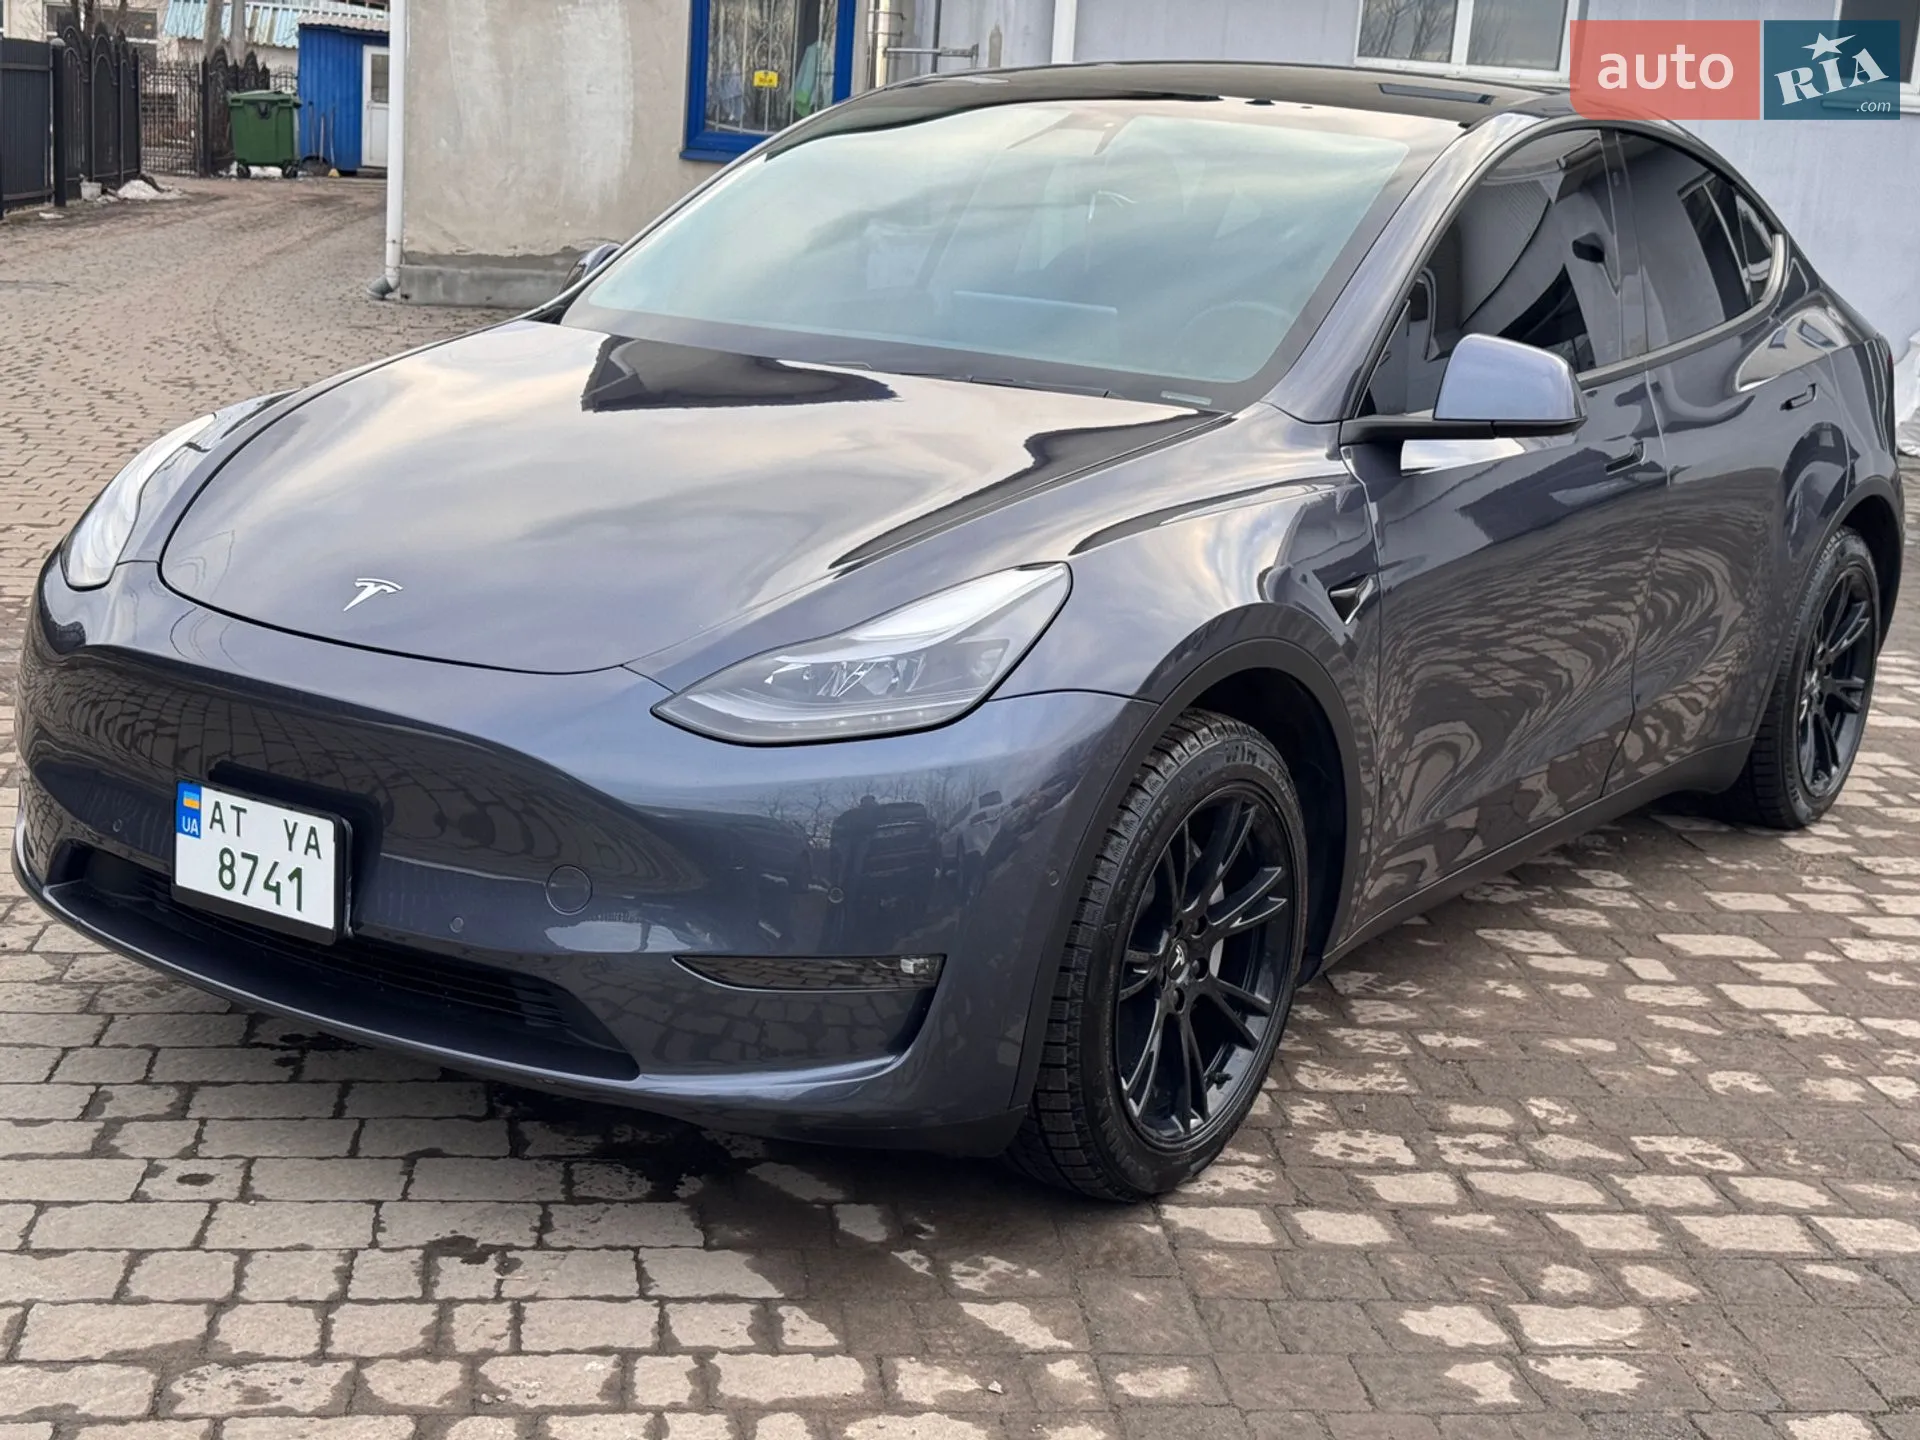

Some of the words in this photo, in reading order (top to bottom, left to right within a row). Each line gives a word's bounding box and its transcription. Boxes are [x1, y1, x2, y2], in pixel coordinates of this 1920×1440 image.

[182, 815, 199, 836] UA
[209, 800, 247, 838] AT
[283, 818, 322, 860] YA
[218, 846, 303, 913] 8741
